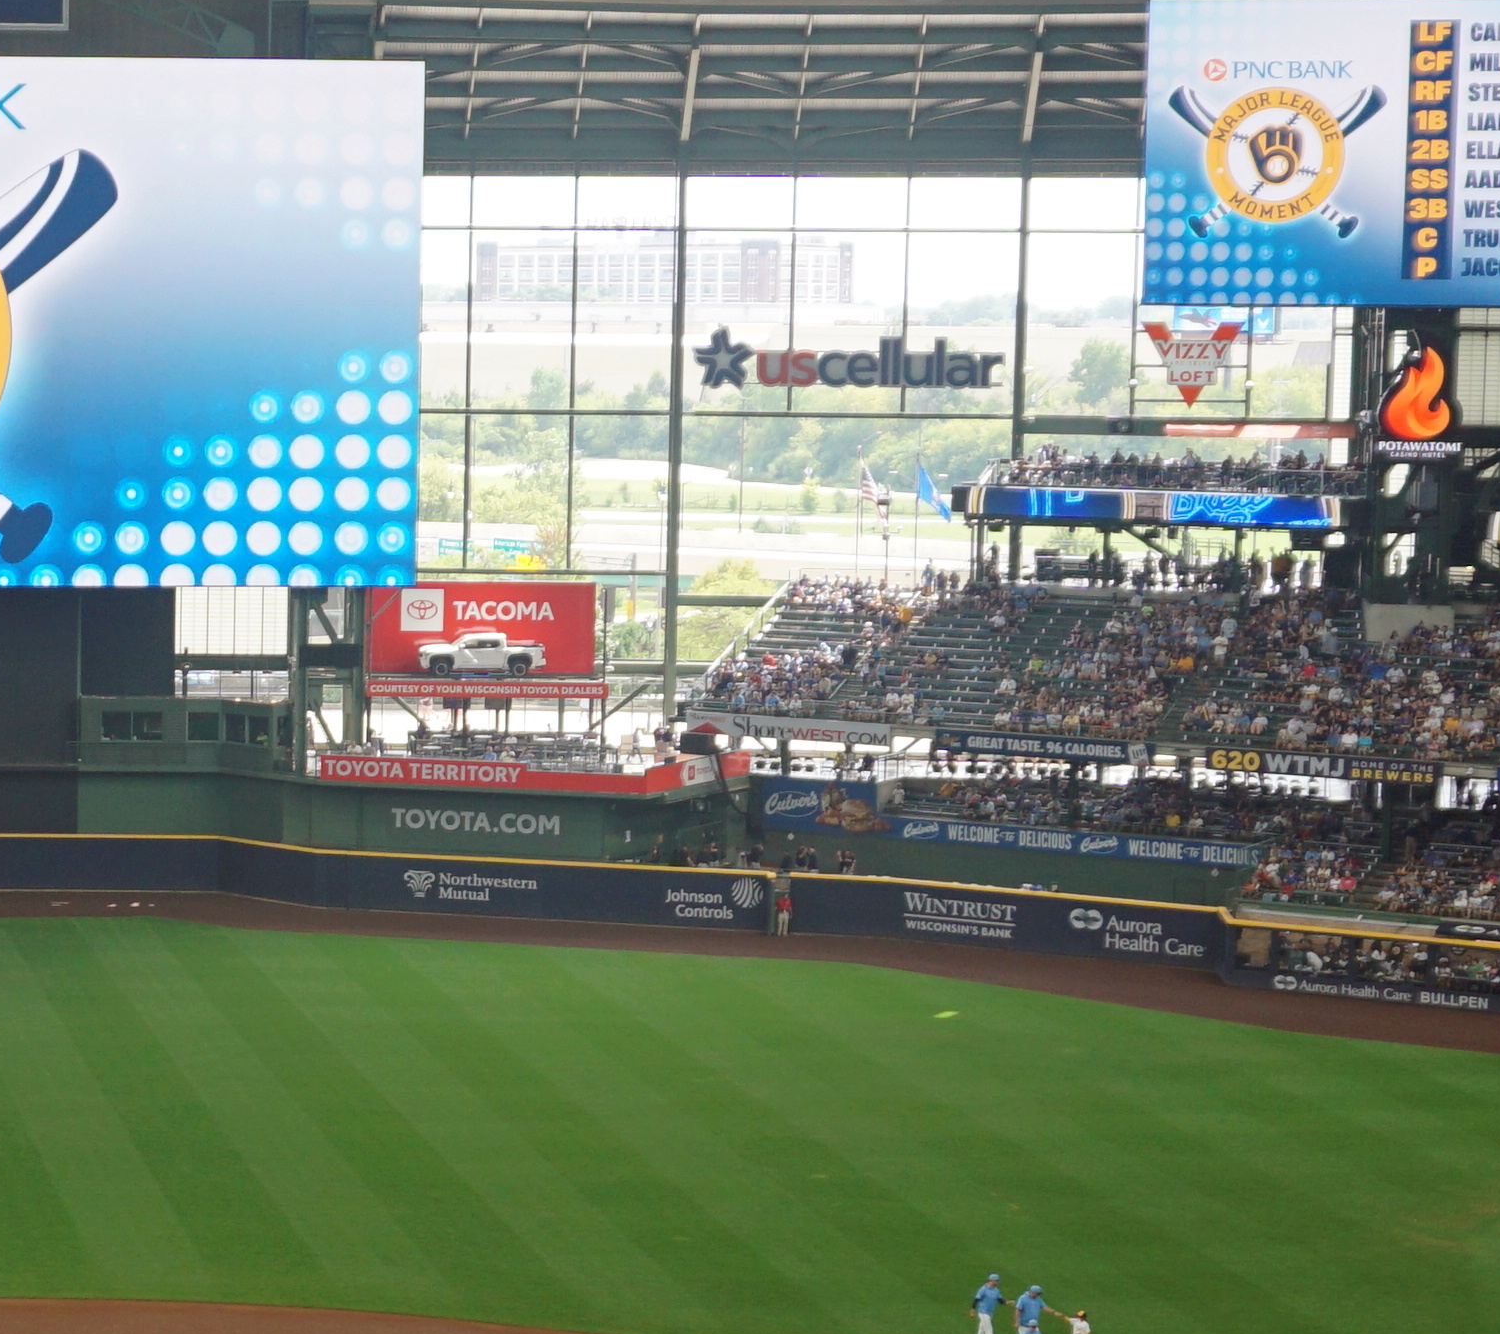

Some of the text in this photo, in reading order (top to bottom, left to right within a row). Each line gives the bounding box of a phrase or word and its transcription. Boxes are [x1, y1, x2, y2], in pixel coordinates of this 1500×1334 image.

[1419, 22, 1451, 42] LF
[1233, 59, 1353, 80] PNC BANK
[1415, 50, 1452, 72] CF
[1414, 80, 1451, 101] RF
[1211, 91, 1338, 144] MAJOR LEAGUE
[1415, 110, 1447, 131] 1B
[1411, 140, 1450, 161] 2B
[1411, 169, 1448, 190] SS
[1228, 190, 1317, 220] MOMENT
[1408, 198, 1448, 220] 3B
[1415, 227, 1438, 249] C
[1416, 257, 1437, 278] P
[1157, 341, 1229, 360] VIZZY
[757, 336, 1004, 389] uscellular
[1169, 370, 1215, 384] LOFT
[1379, 441, 1463, 452] POTAWATOMI
[453, 600, 555, 622] TACOMA
[369, 681, 605, 698] COURTESY OF YOUR WISCONSIN TOYOTA DEALERS
[966, 735, 1126, 759] GREAT TASTE. 96 CALORIES.
[325, 758, 522, 784] TOYOTA TERRITORY
[1211, 749, 1345, 778] 620 WTMJ
[1350, 767, 1435, 783] BREWERS
[763, 789, 823, 818] Culver's
[391, 808, 561, 835] TOYOTA.COM
[438, 872, 538, 893] Northwestern
[438, 884, 490, 902] Mutual
[665, 888, 724, 907] Johnson
[903, 891, 1017, 923] WINTRUST
[675, 903, 734, 921] Controls
[906, 919, 1012, 939] WISCONSIN'S BANK
[1106, 914, 1163, 936] Aurora
[1104, 933, 1205, 957] Health Care
[1299, 978, 1489, 1010] Aurora Health Care BULLPEN
